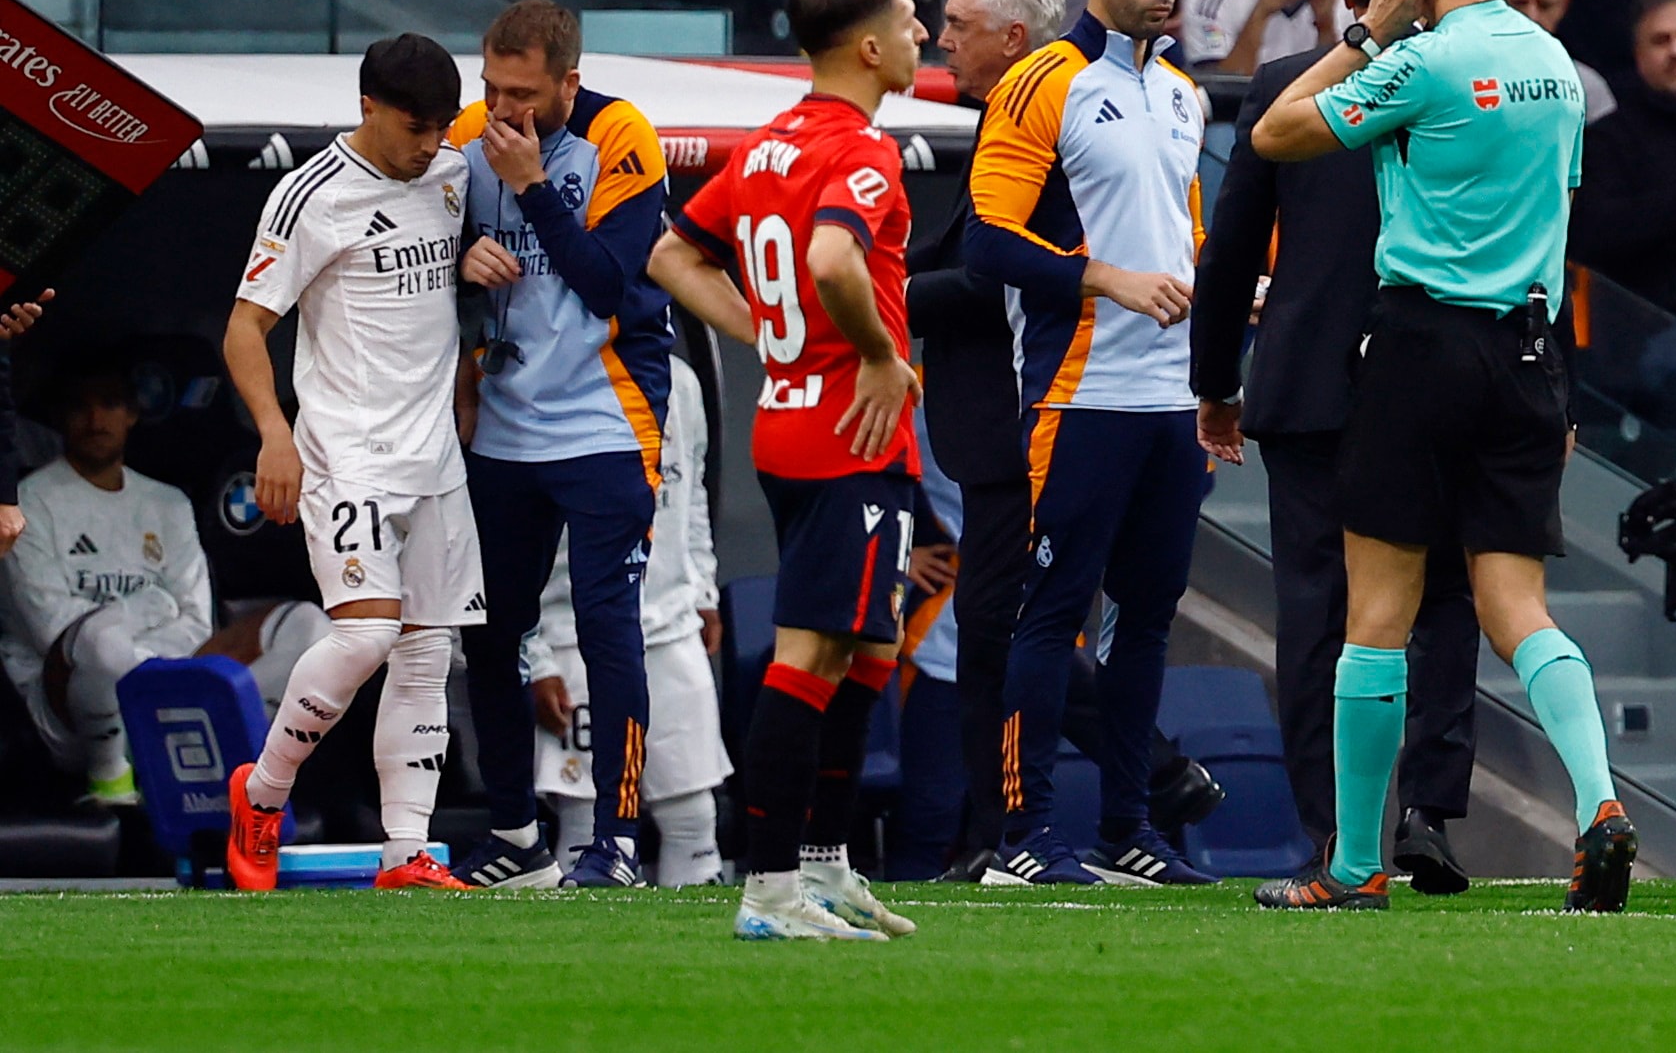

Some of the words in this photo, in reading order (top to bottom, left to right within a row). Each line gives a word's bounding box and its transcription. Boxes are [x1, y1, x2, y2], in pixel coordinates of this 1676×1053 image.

[61, 83, 101, 111] FLY
[87, 99, 148, 143] BETTER
[743, 139, 802, 179] BRYAN
[398, 270, 423, 296] FLY
[736, 214, 806, 365] 19
[332, 500, 382, 554] 21
